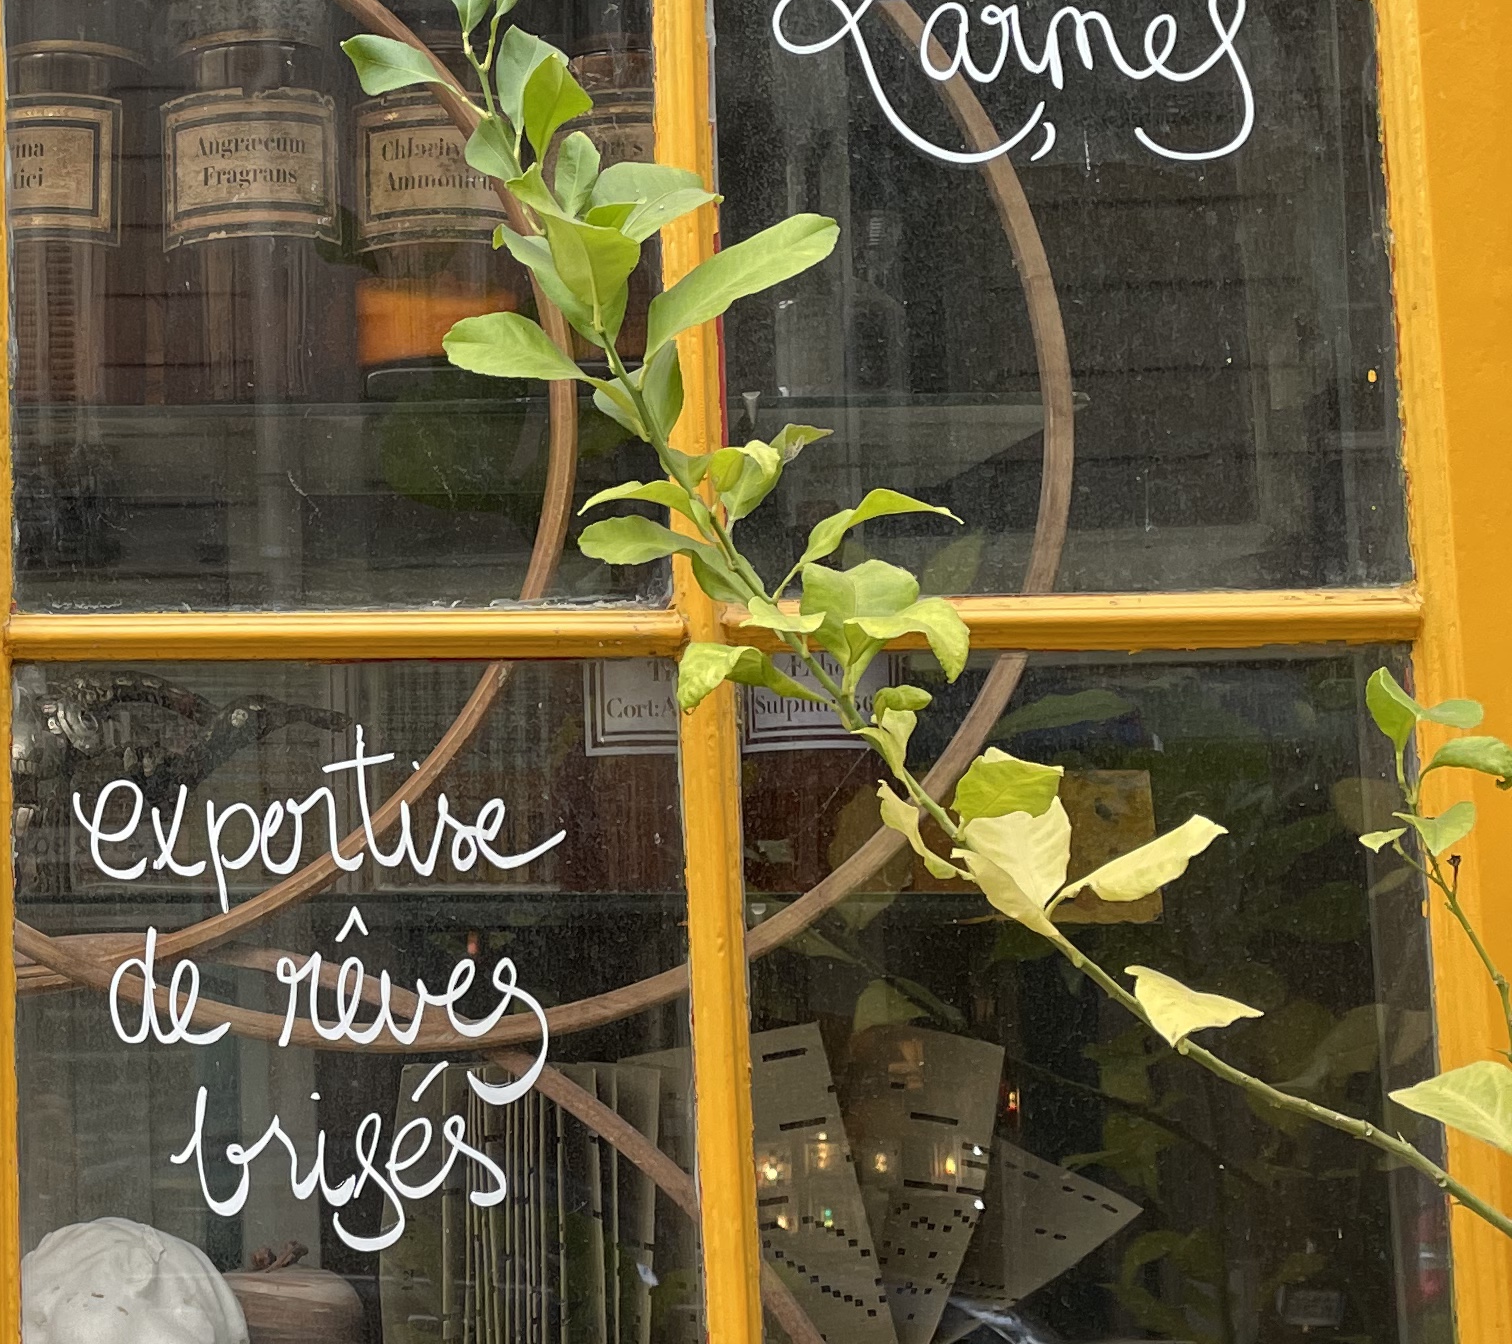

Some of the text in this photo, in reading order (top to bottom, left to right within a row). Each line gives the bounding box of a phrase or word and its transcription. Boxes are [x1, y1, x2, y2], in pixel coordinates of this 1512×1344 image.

[9, 138, 44, 158] ina
[203, 166, 298, 189] Fragrans
[72, 724, 567, 914] expertise
[109, 906, 549, 1106] de rêves
[170, 1060, 507, 1252] brisés
